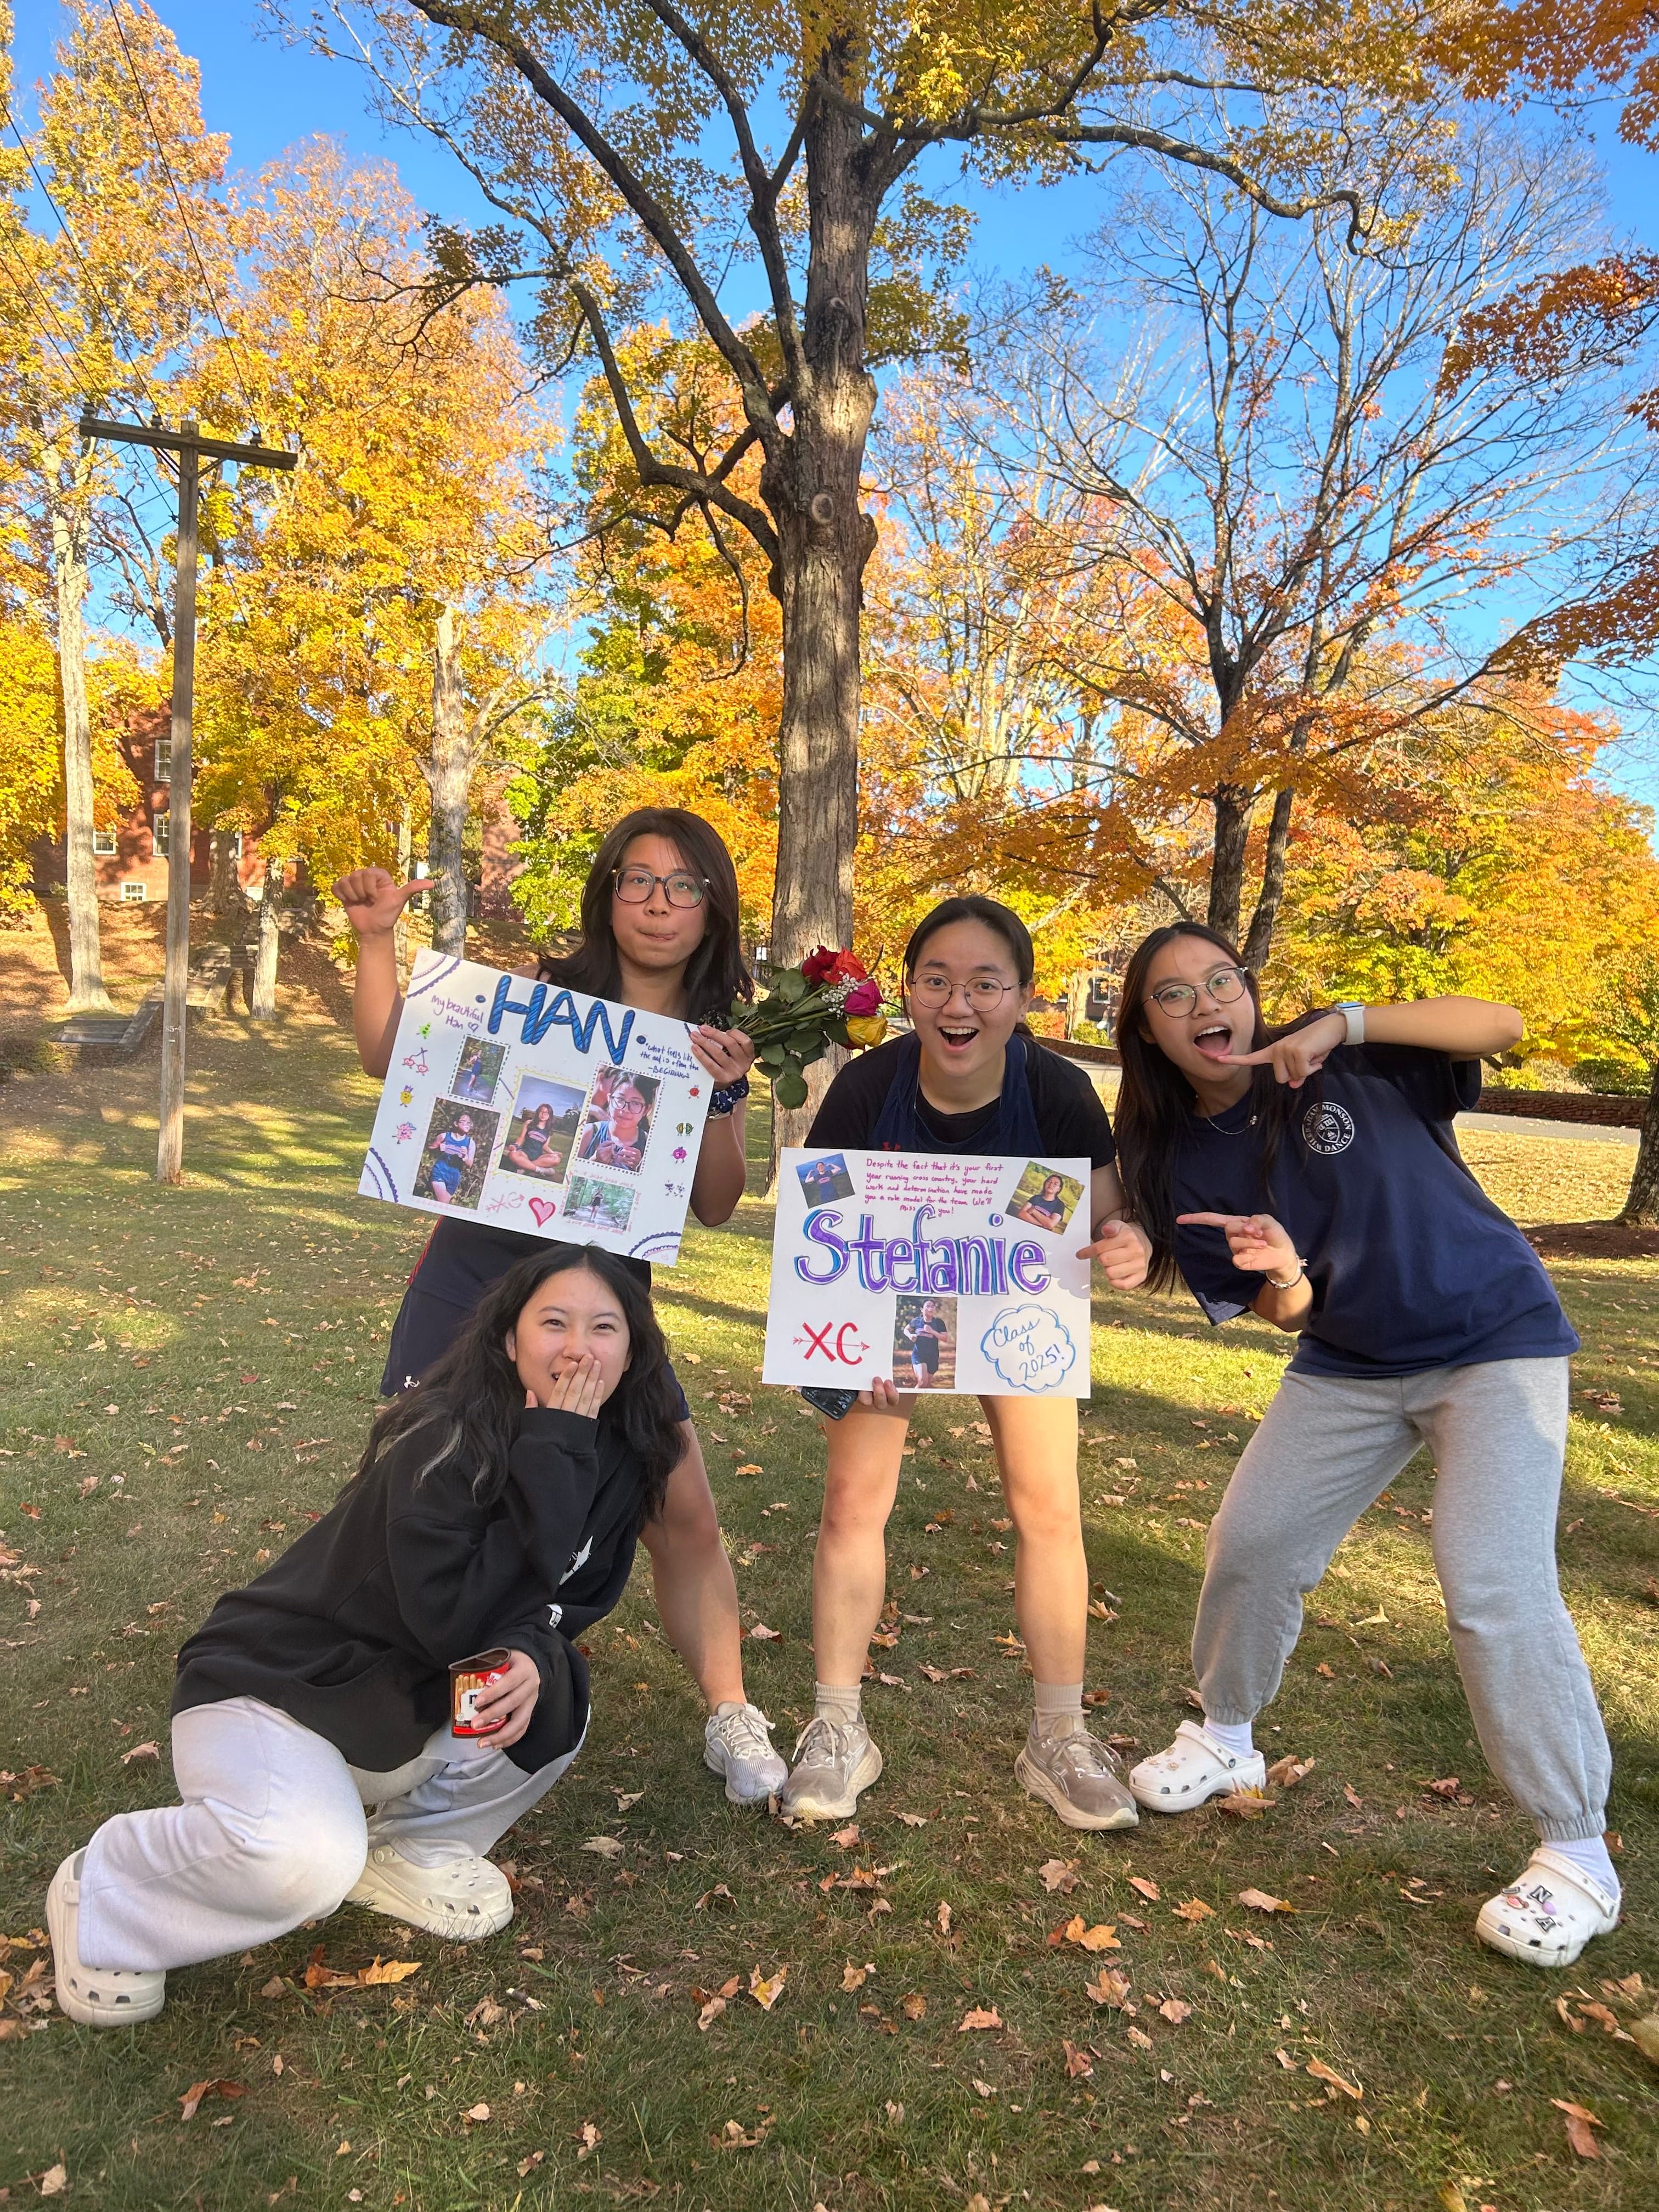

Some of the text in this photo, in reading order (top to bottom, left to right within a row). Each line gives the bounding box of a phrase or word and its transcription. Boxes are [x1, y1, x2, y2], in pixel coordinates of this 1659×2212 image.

[446, 997, 484, 1024] beautiful
[488, 975, 635, 1065] HAN
[445, 1014, 463, 1030] Han
[640, 1051, 650, 1059] the
[667, 1047, 681, 1060] feels
[683, 1052, 692, 1063] like
[1322, 1104, 1352, 1130] MONSON
[1324, 1133, 1351, 1152] DANCE
[866, 1159, 1003, 1176] Despite the fact that it's your first
[867, 1172, 882, 1183] year
[885, 1175, 909, 1183] running
[962, 1177, 977, 1186] your
[865, 1194, 876, 1204] you
[973, 1197, 992, 1206] We'll
[953, 1186, 967, 1195] have
[971, 1187, 992, 1195] made
[938, 1206, 954, 1217] you!
[794, 1204, 1051, 1296] Stefanie
[994, 1318, 1040, 1347] Class
[802, 1321, 862, 1365] XC
[1019, 1335, 1034, 1356] of
[1019, 1344, 1065, 1381] 2025!
